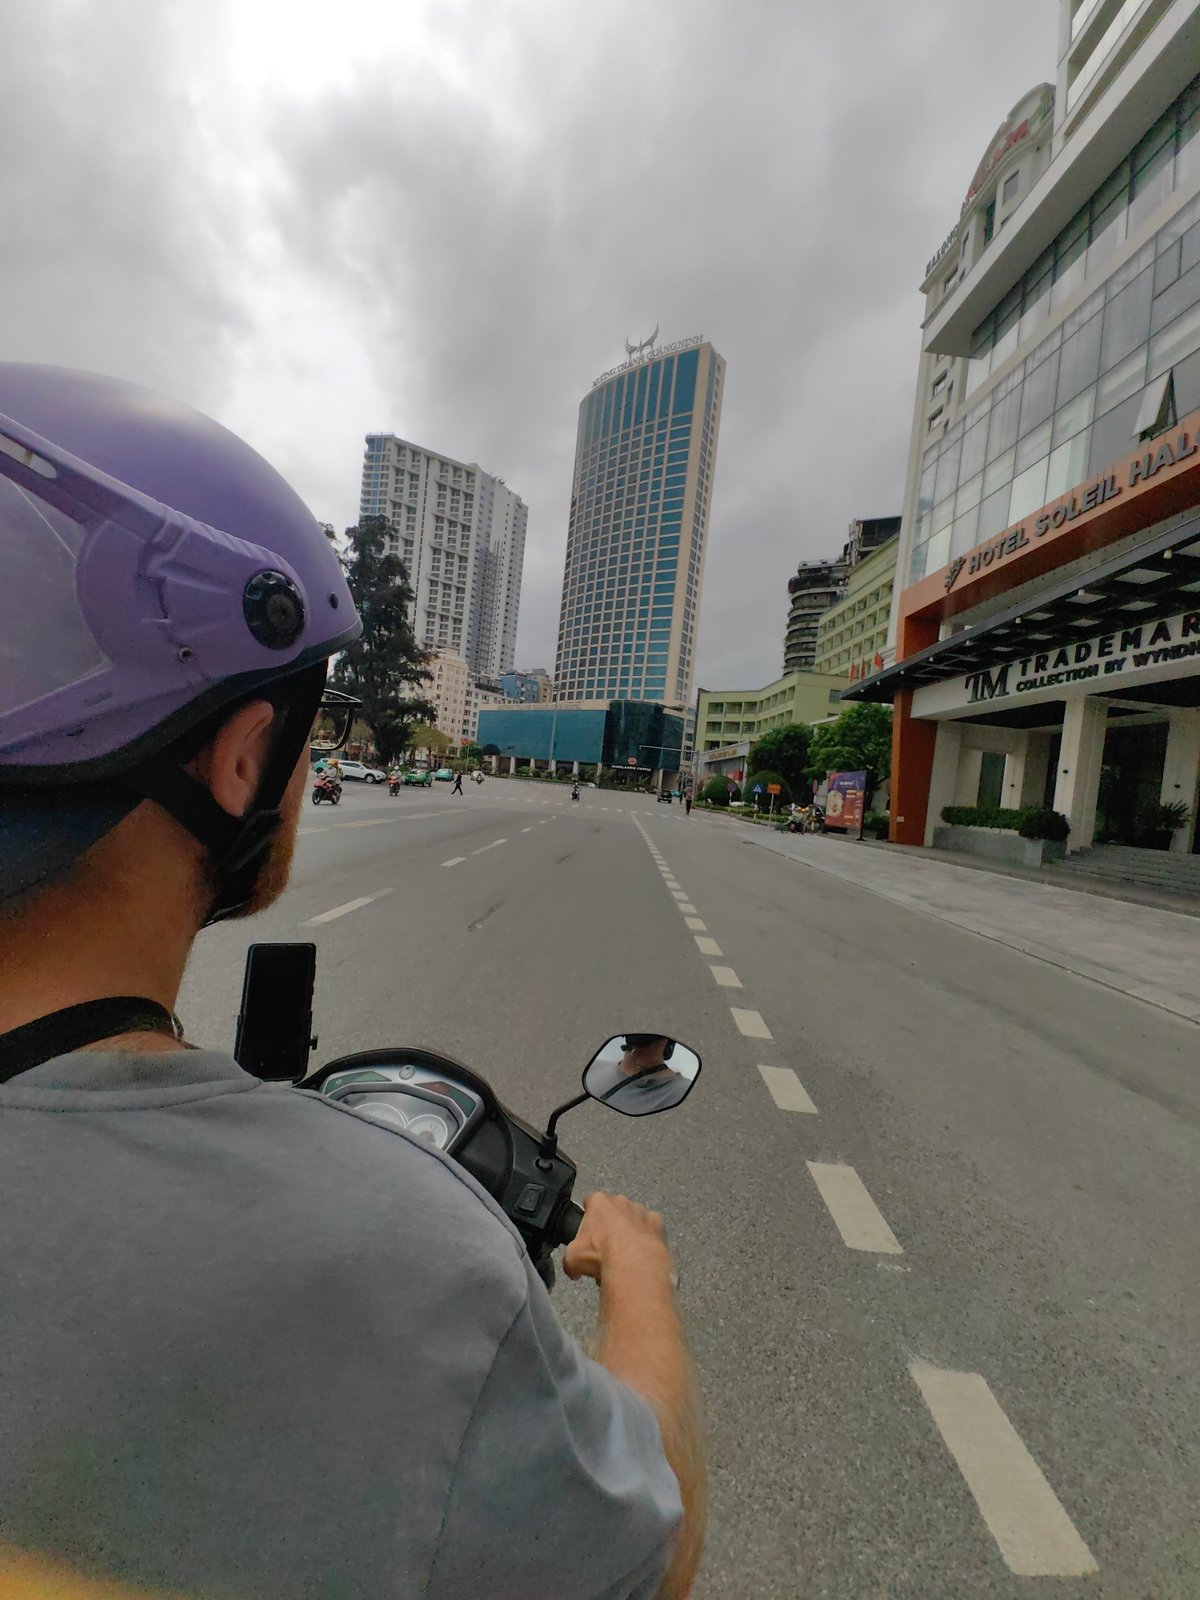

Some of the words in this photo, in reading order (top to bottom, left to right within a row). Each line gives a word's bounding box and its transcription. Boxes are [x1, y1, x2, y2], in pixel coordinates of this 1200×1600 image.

[967, 527, 1030, 575] HOTEL
[1034, 474, 1122, 538] SOLEIL
[1016, 664, 1099, 692] COLLECTION
[1104, 657, 1127, 674] BY
[1019, 612, 1200, 676] TRADEMAR
